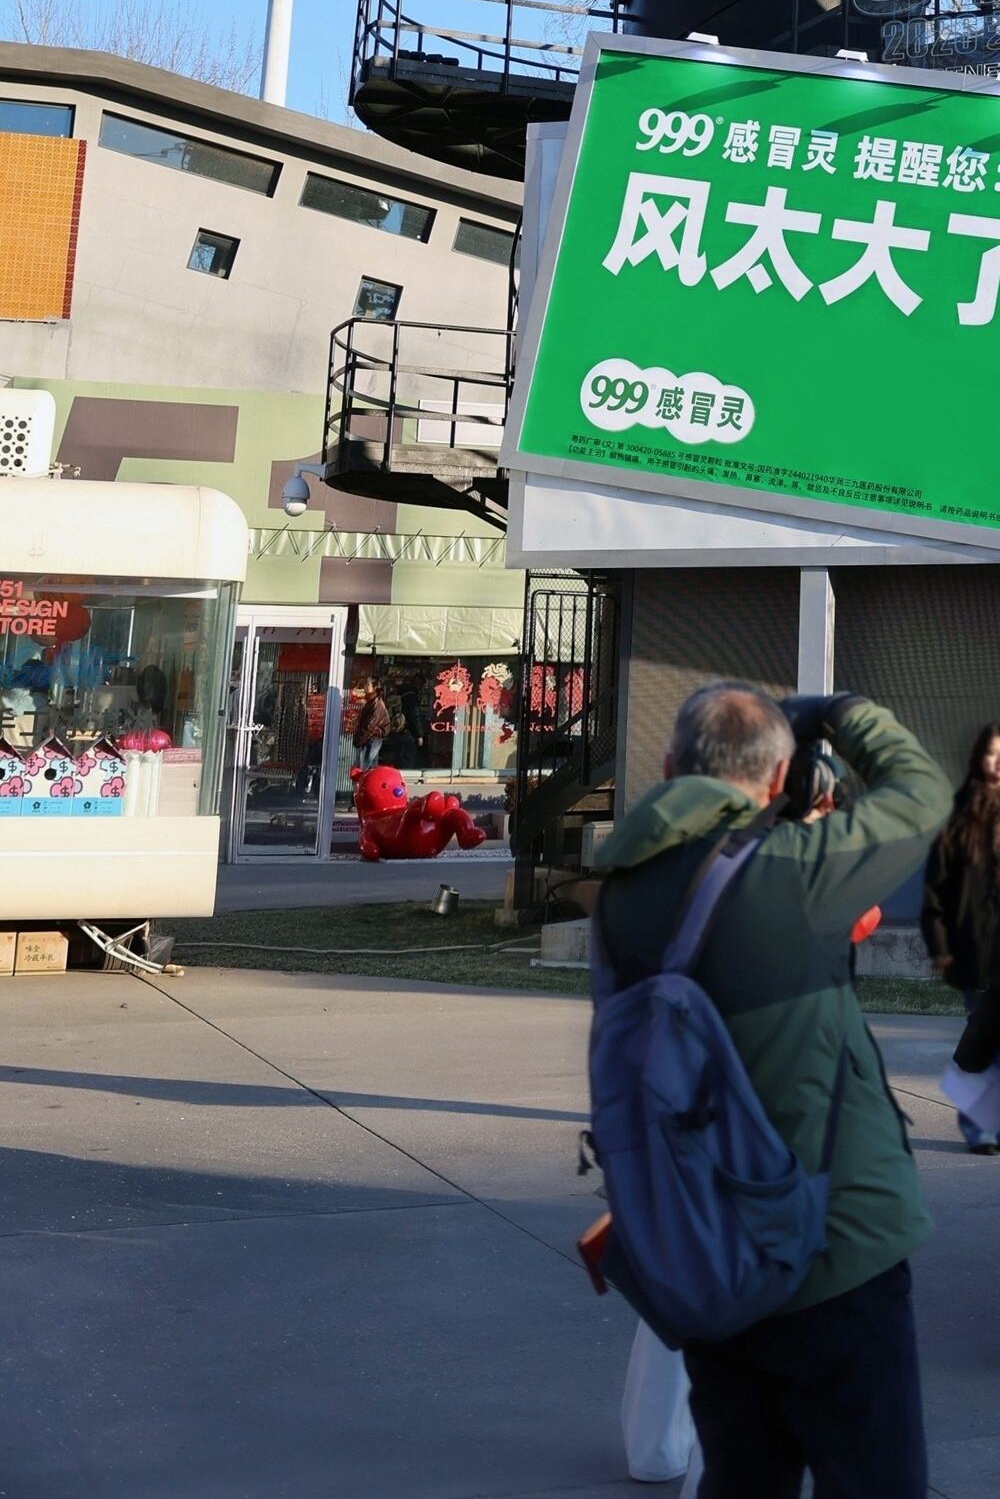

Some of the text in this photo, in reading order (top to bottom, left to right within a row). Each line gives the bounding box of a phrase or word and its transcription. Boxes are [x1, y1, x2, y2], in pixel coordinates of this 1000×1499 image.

[635, 107, 714, 157] 999
[722, 119, 839, 175] 感冒灵
[588, 375, 745, 431] 999 感冒灵
[0, 580, 23, 598] 51
[0, 599, 68, 618] ESIGN
[0, 617, 57, 635] TORE
